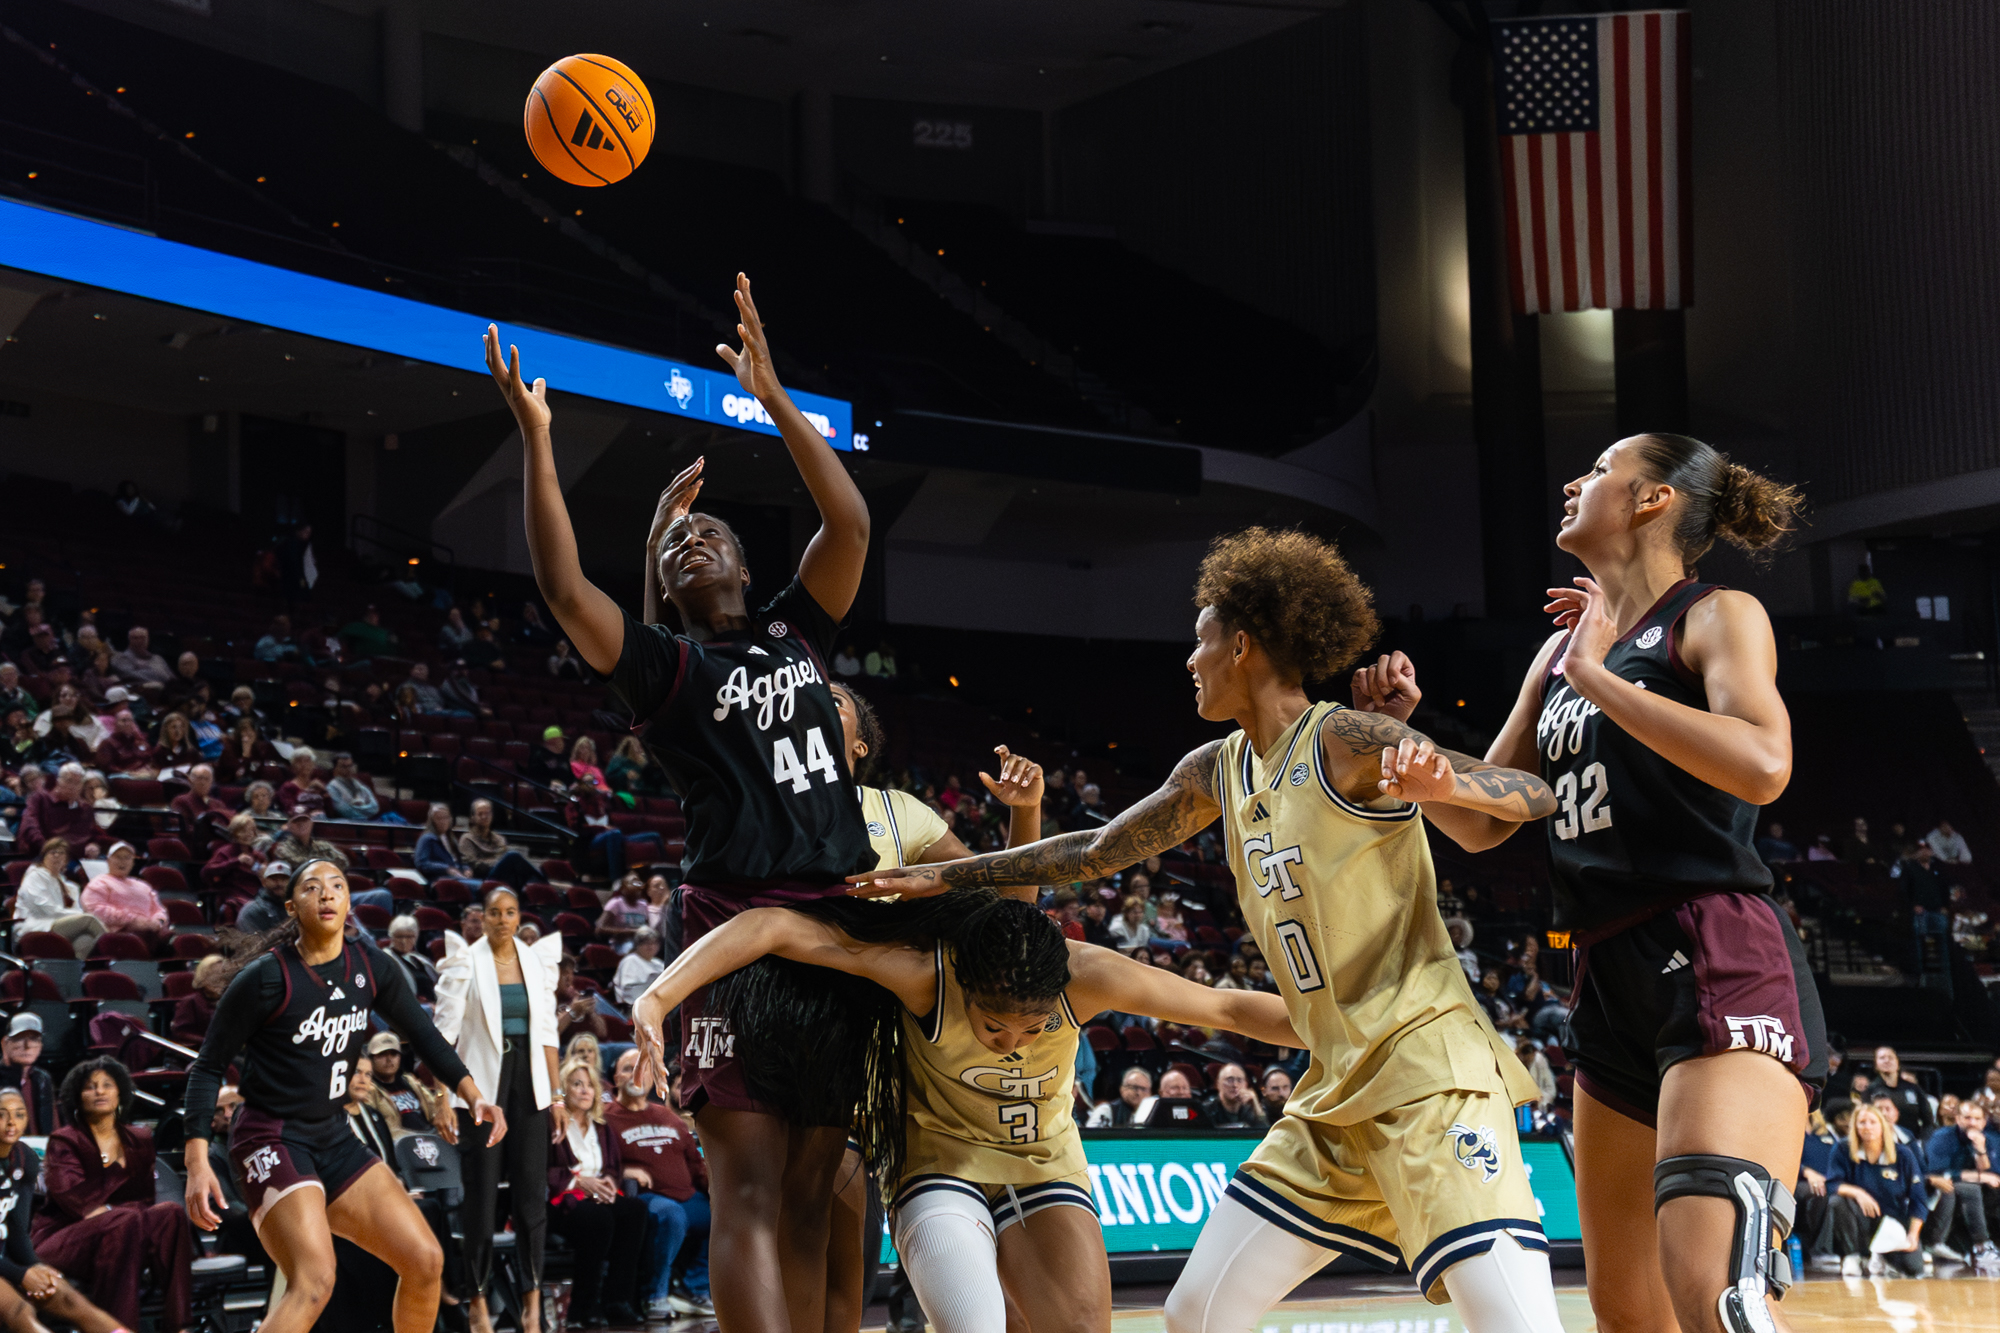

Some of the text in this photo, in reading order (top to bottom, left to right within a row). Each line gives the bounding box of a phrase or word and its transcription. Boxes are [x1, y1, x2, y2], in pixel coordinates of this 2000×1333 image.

[605, 88, 640, 133] PRO
[913, 121, 973, 149] 225
[773, 726, 839, 794] 44
[1555, 762, 1612, 840] 32
[1243, 832, 1304, 901] GT
[1275, 919, 1325, 994] 0
[329, 1060, 349, 1100] 6
[959, 1065, 1058, 1100] GT
[999, 1101, 1038, 1144] 3
